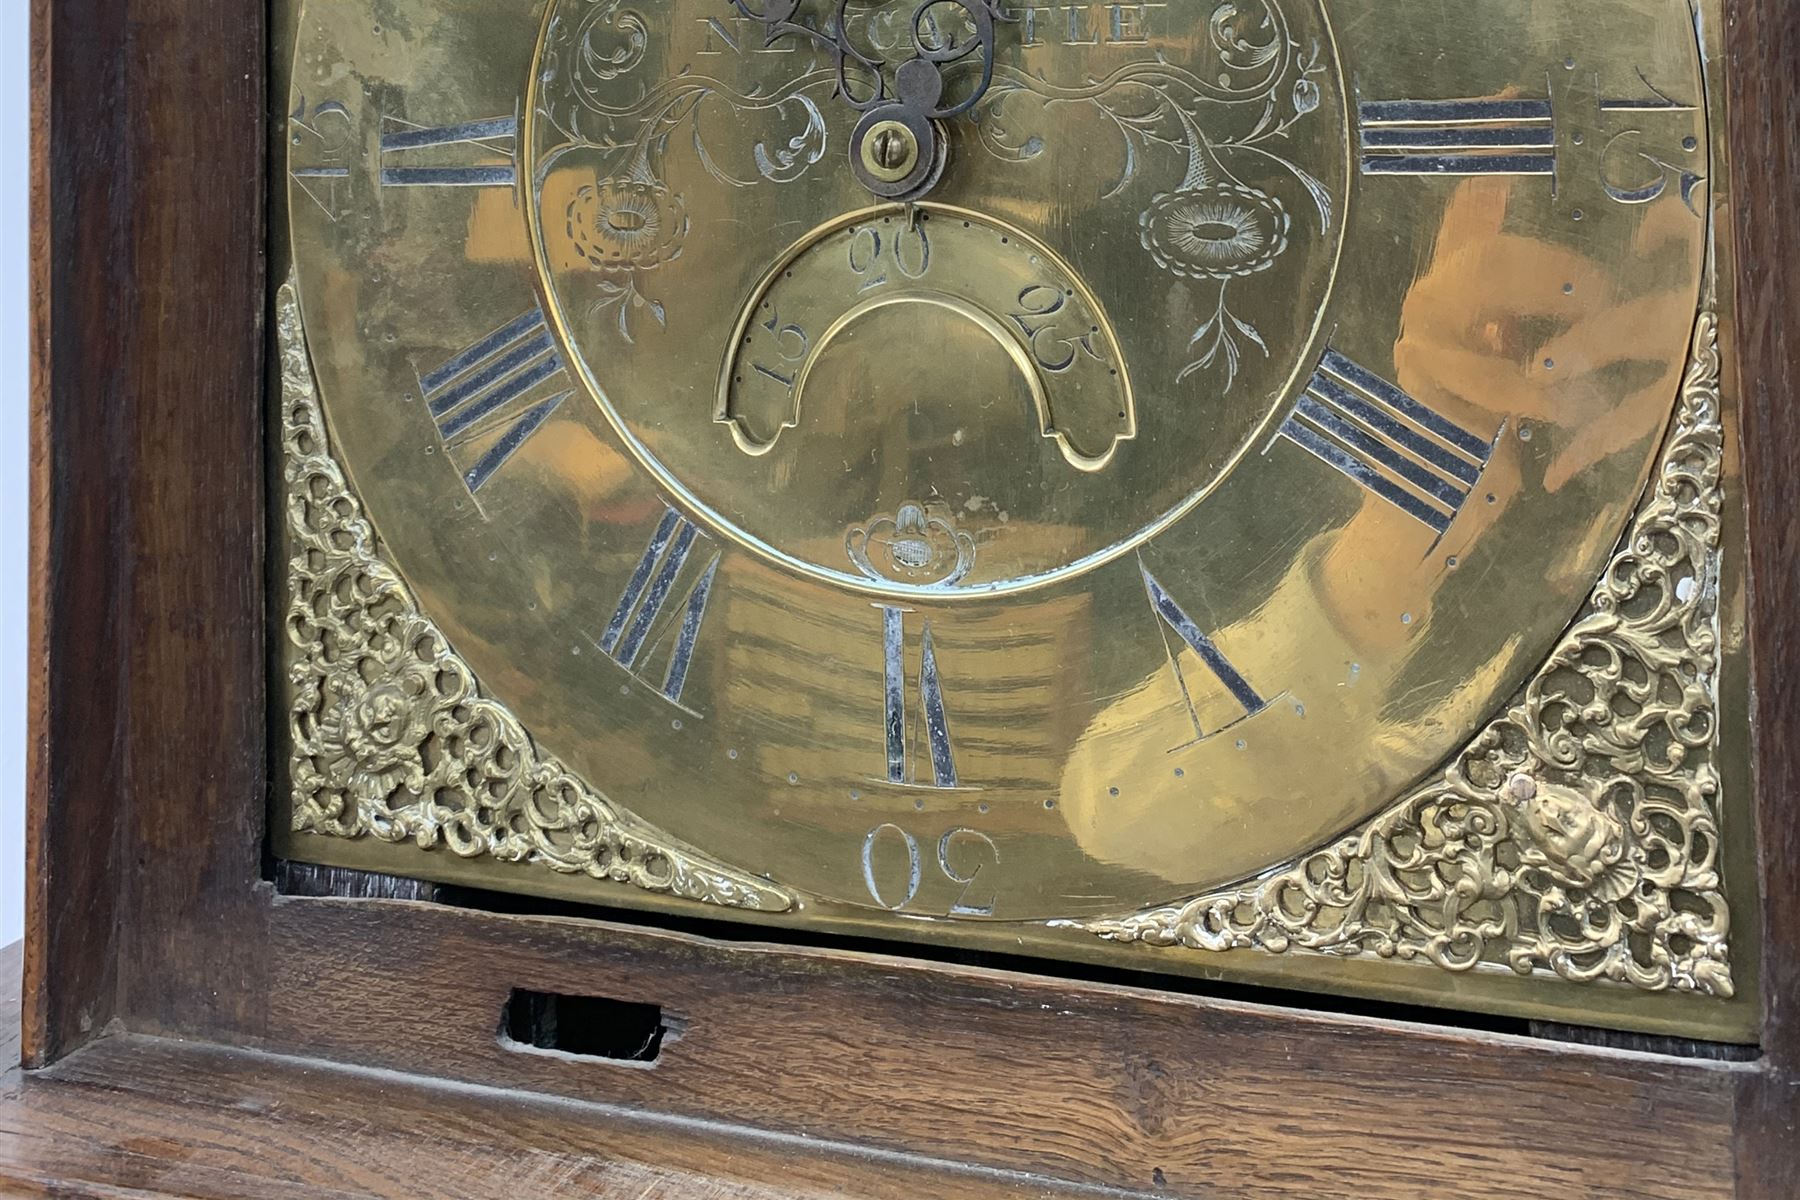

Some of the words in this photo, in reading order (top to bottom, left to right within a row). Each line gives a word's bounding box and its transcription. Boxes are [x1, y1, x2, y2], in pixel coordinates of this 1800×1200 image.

[289, 84, 351, 222] 45
[380, 90, 519, 225] IX
[1354, 70, 1558, 200] III
[1600, 65, 1707, 219] 15
[848, 222, 931, 295] 20
[748, 307, 810, 398] 15
[1005, 284, 1106, 373] 25
[406, 287, 577, 523] VIII
[1260, 322, 1508, 560] IIII
[579, 492, 723, 719] VII
[1135, 546, 1291, 754] V
[866, 602, 985, 792] VI
[861, 822, 1001, 918] 30
